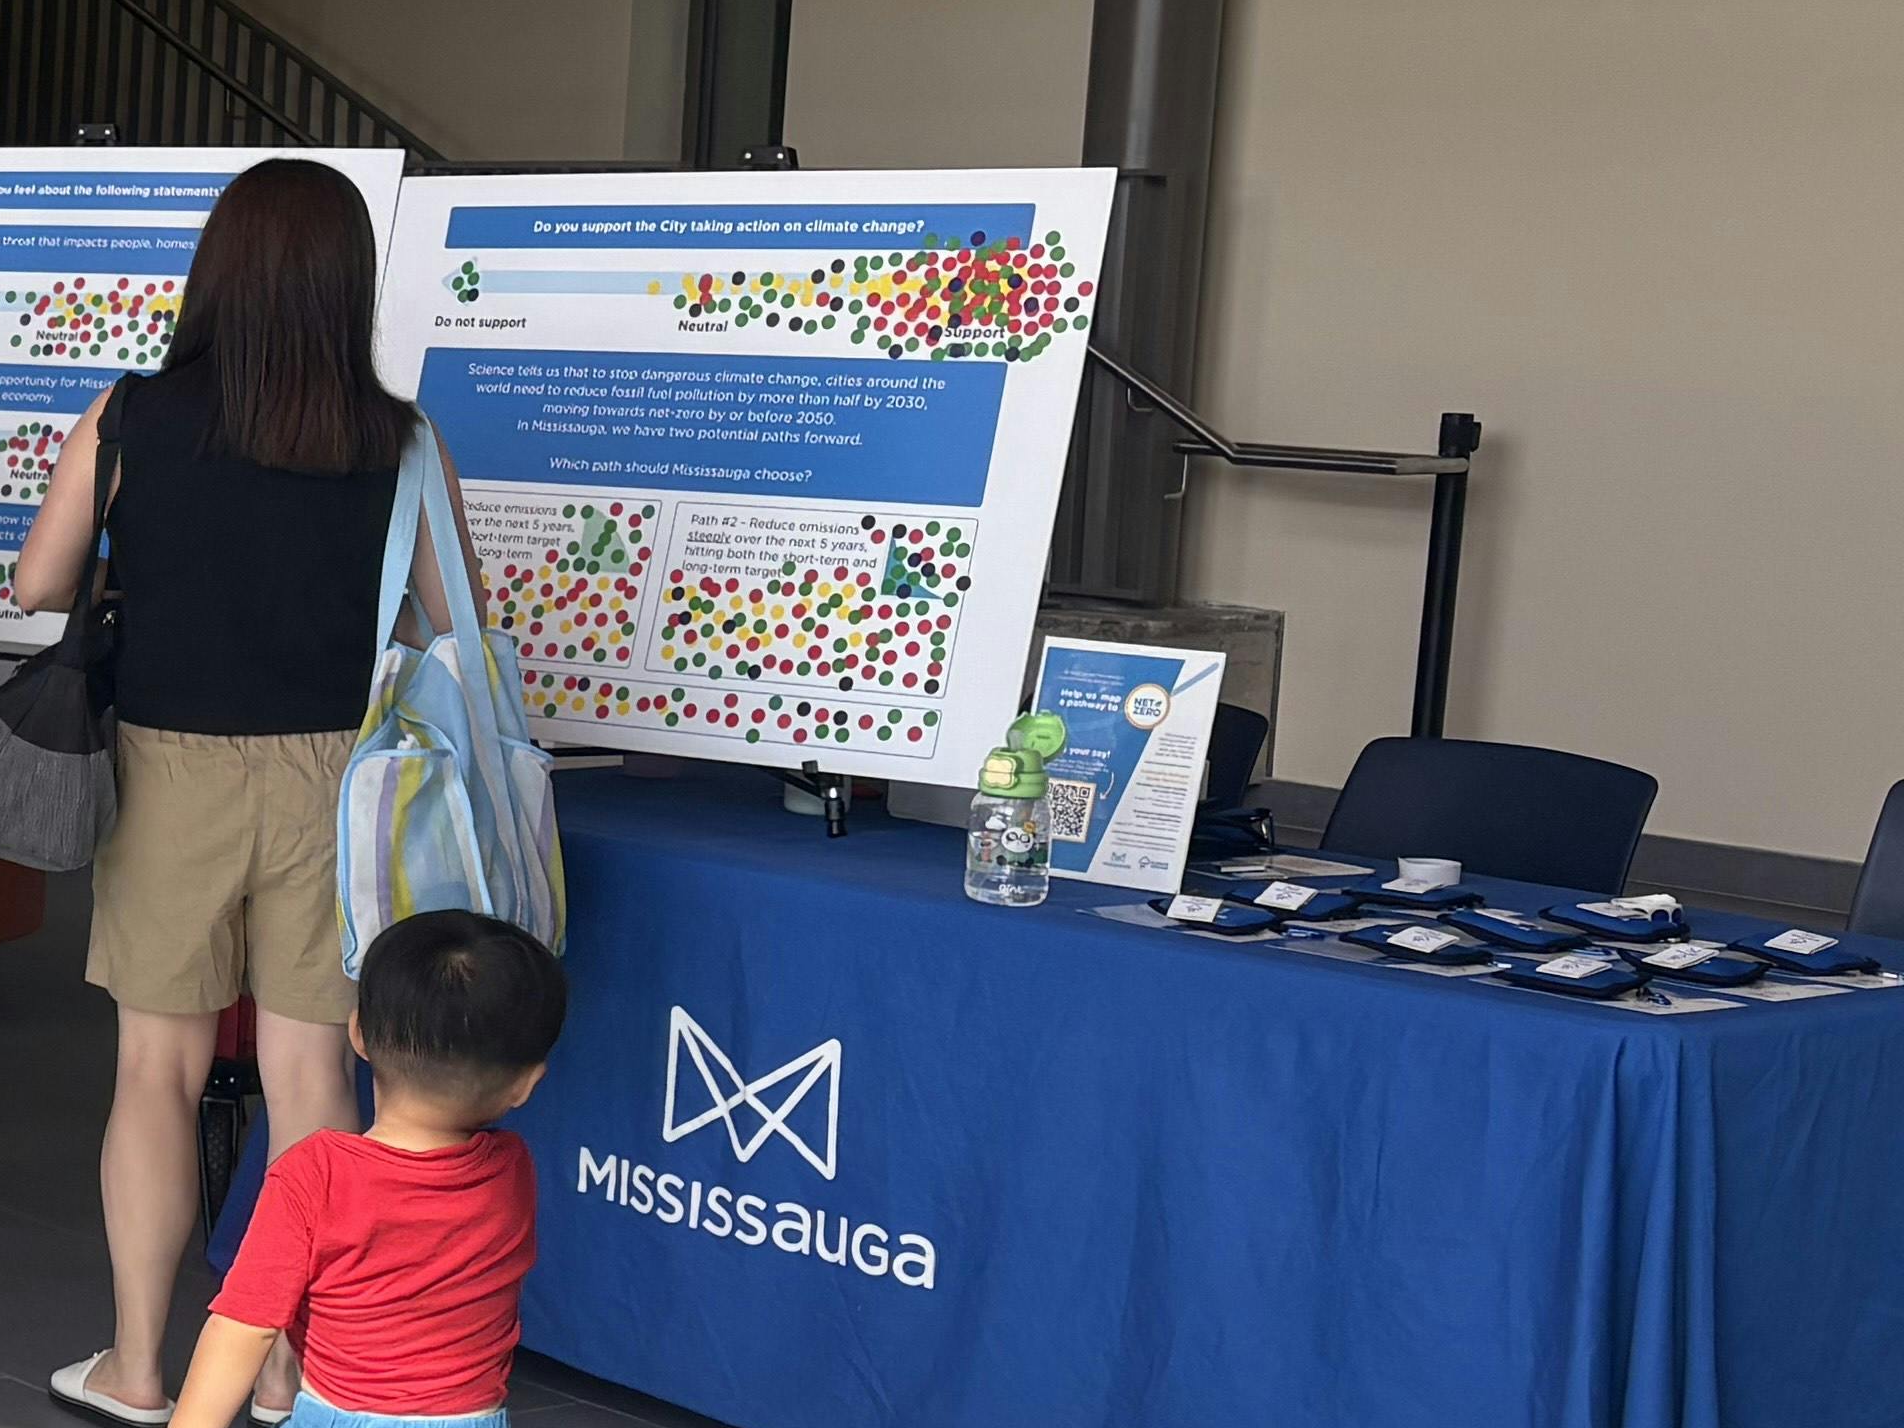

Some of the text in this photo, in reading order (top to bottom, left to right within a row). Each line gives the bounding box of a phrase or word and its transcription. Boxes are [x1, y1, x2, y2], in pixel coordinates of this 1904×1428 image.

[13, 184, 36, 194] feel
[37, 184, 71, 195] about
[73, 184, 92, 195] the
[95, 184, 150, 197] following
[533, 219, 924, 234] Do you support the City taking action on climate change?
[2, 236, 35, 246] threat
[38, 236, 60, 246] that
[63, 238, 108, 247] impacts
[434, 315, 526, 329] Do not support
[678, 320, 728, 331] Neutral
[35, 330, 80, 343] Neutral
[944, 326, 1005, 340] Support
[60, 376, 76, 387] for
[468, 363, 514, 375] Science
[545, 368, 559, 376] us
[563, 366, 588, 377] that
[592, 367, 606, 378] to
[609, 368, 638, 379] stop
[640, 369, 711, 382] dangerous
[714, 370, 764, 383] climate
[825, 374, 862, 386] cities
[866, 376, 918, 388] around
[922, 377, 946, 389] the
[476, 382, 510, 393] world
[512, 383, 544, 394] need
[547, 384, 561, 395] to
[563, 386, 607, 396] reduce
[610, 385, 644, 397] fossil
[647, 387, 672, 399] fuel
[674, 388, 734, 401] pollution
[737, 390, 755, 404] by
[758, 393, 794, 403] more
[798, 392, 830, 404] than
[833, 393, 860, 405] half
[863, 394, 882, 409] by
[542, 404, 589, 416] moving
[592, 405, 644, 416] towards
[648, 408, 704, 419] net-zero
[708, 408, 726, 422] by
[728, 411, 744, 420] or
[747, 409, 792, 423] before
[517, 419, 528, 430] In
[612, 425, 630, 434] we
[633, 424, 665, 436] have
[669, 426, 694, 437] two
[696, 428, 758, 440] potential
[761, 430, 800, 442] paths
[550, 457, 812, 481] Which path should Mississauga choose?
[690, 514, 862, 535] Path #2 Reduce emissions
[1066, 699, 1106, 712] pathway
[1107, 703, 1119, 712] to
[1134, 698, 1155, 706] NET
[1133, 706, 1162, 717] ZERO
[1069, 747, 1111, 759] your say!
